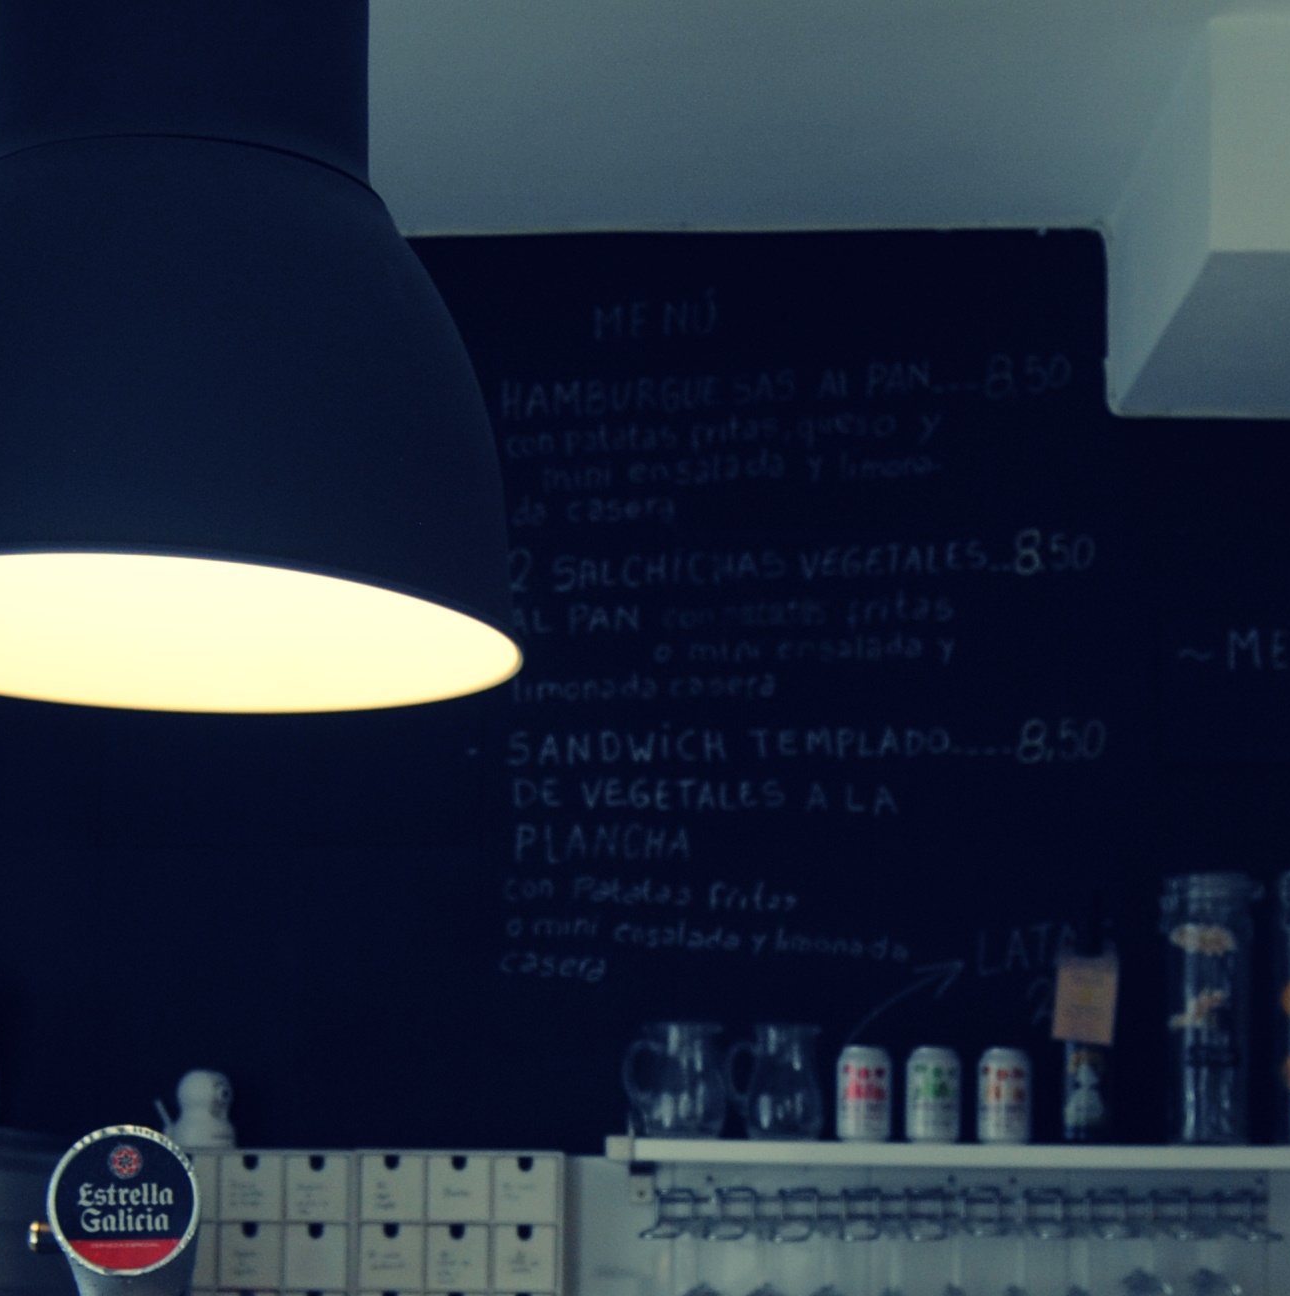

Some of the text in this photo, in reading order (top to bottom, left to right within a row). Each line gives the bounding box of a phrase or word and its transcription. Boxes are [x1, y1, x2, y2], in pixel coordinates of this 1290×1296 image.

[867, 358, 930, 398] PAN
[507, 547, 533, 592] 2
[799, 539, 988, 580] VEGETALES
[568, 602, 640, 635] PAN
[747, 724, 952, 760] TEMPLADO
[513, 776, 900, 817] DE VEGETALES A LA
[514, 822, 691, 864] PLANCHA
[975, 920, 1095, 976] LATA
[77, 1182, 174, 1207] Estrella
[80, 1207, 170, 1233] Galicia
